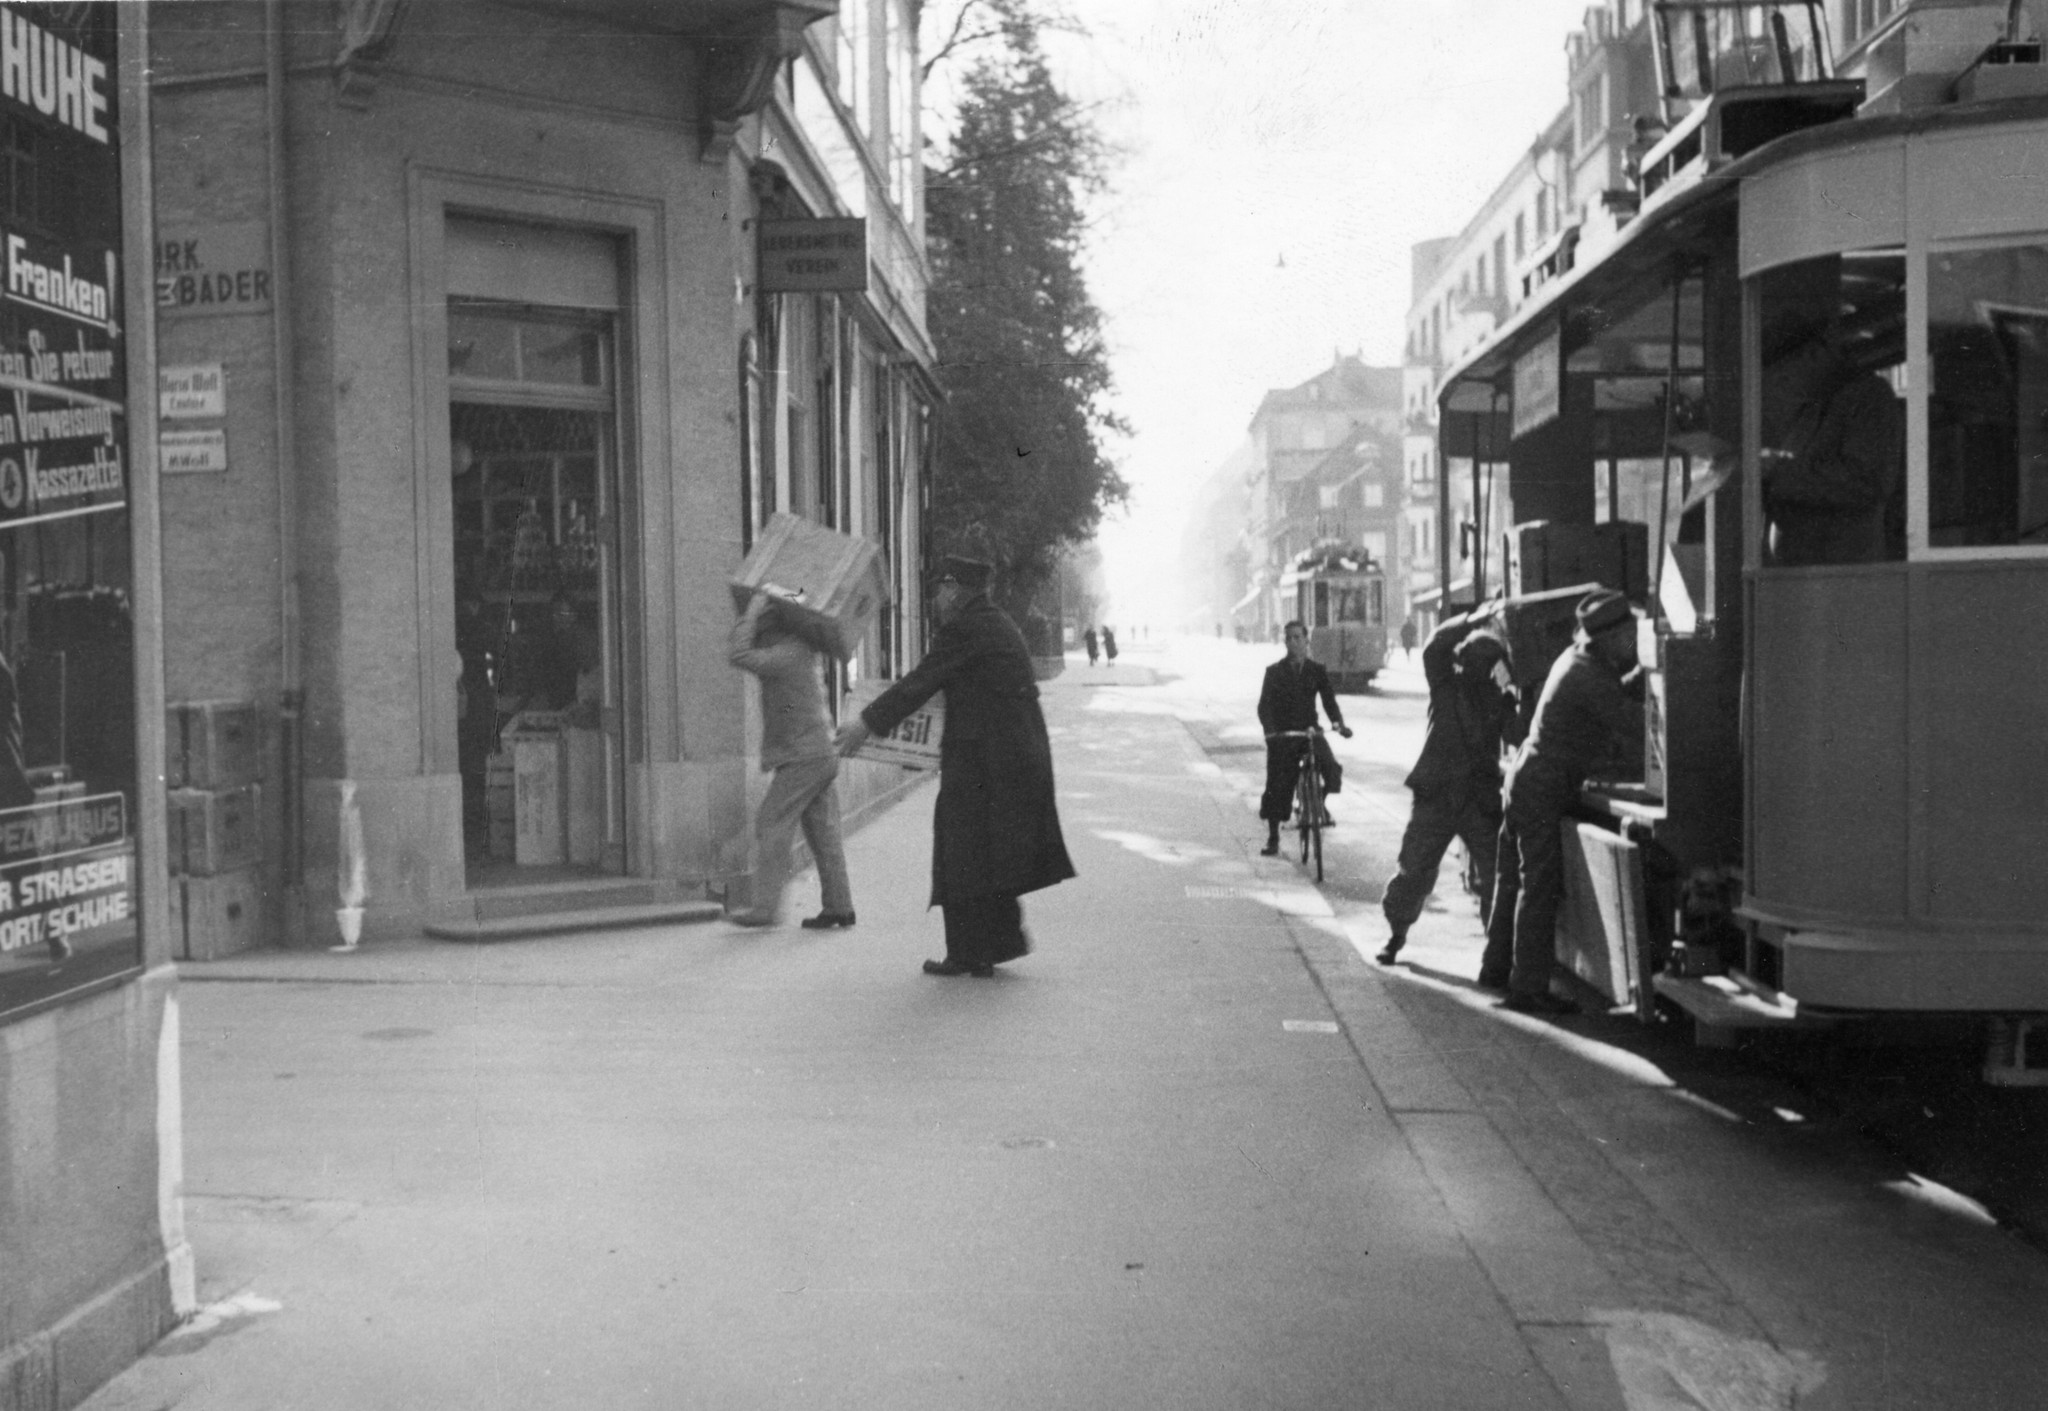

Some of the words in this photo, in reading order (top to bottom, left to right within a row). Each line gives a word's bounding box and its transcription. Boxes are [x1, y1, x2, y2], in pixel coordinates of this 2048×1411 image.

[1, 6, 108, 144] HUHE
[8, 233, 118, 339] Franken!
[28, 328, 60, 382] Sie
[62, 328, 113, 381] retour
[14, 390, 114, 446] Vorweisung
[24, 444, 123, 501] Kassazettel
[20, 855, 128, 907] STRASSEN
